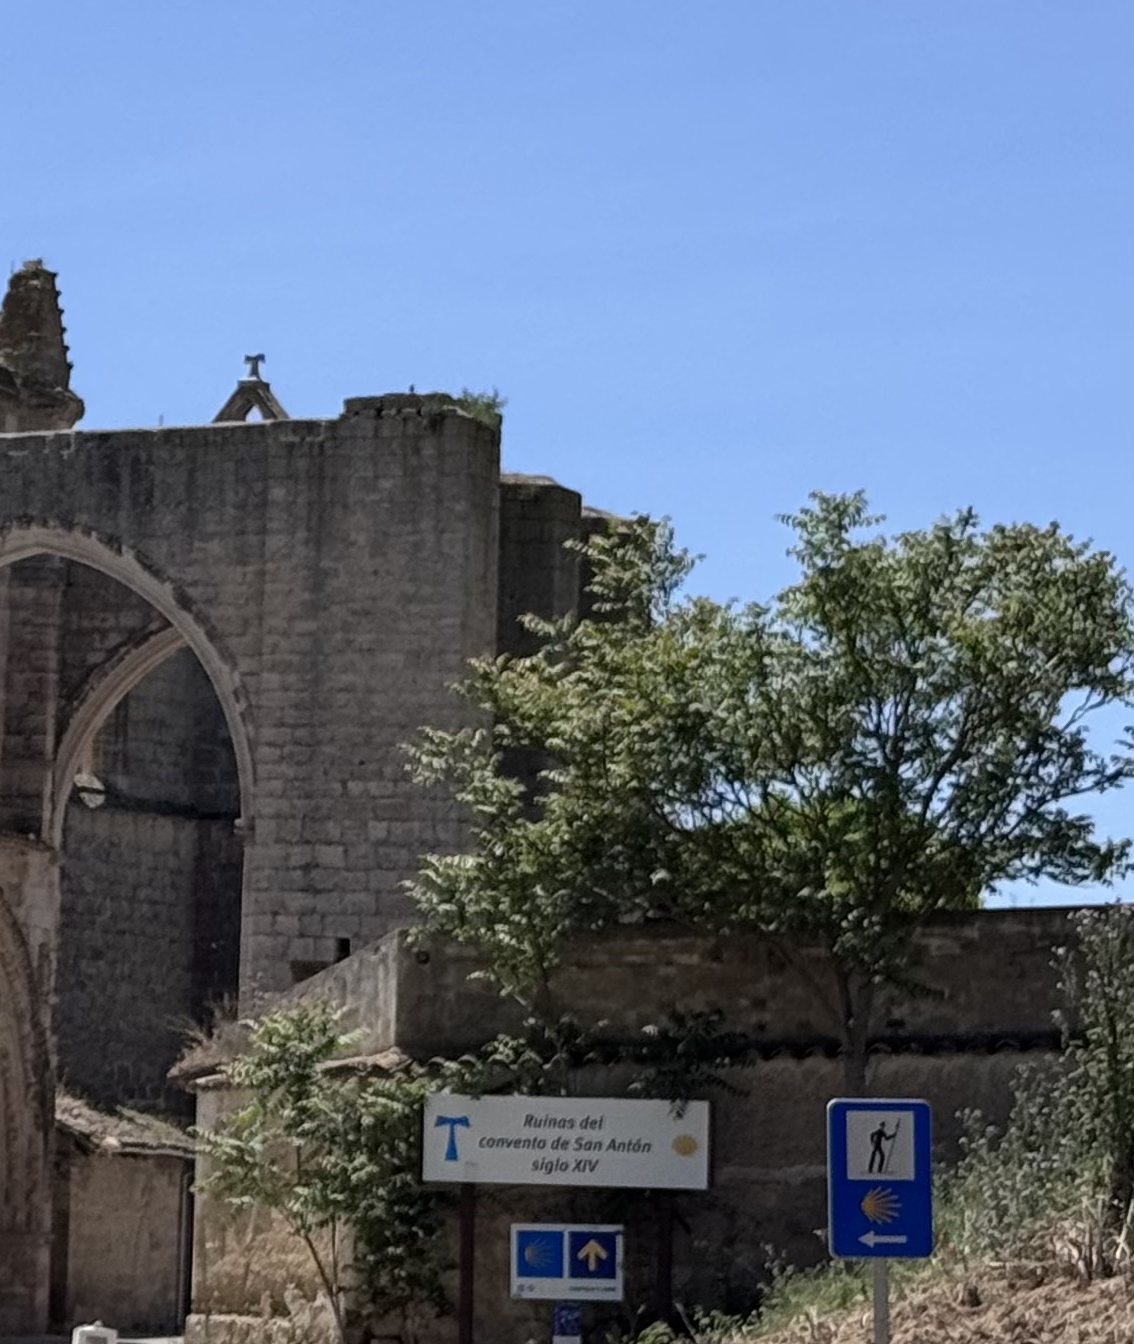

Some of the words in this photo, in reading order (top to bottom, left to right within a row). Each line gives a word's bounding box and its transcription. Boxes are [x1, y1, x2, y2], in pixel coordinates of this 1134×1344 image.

[523, 1113, 575, 1129] Ruinas
[579, 1114, 604, 1130] del
[478, 1136, 547, 1150] convento
[550, 1136, 570, 1151] de
[572, 1136, 603, 1152] San
[605, 1137, 652, 1153] Antón
[531, 1157, 569, 1175] siglo
[571, 1158, 599, 1173] XIV
